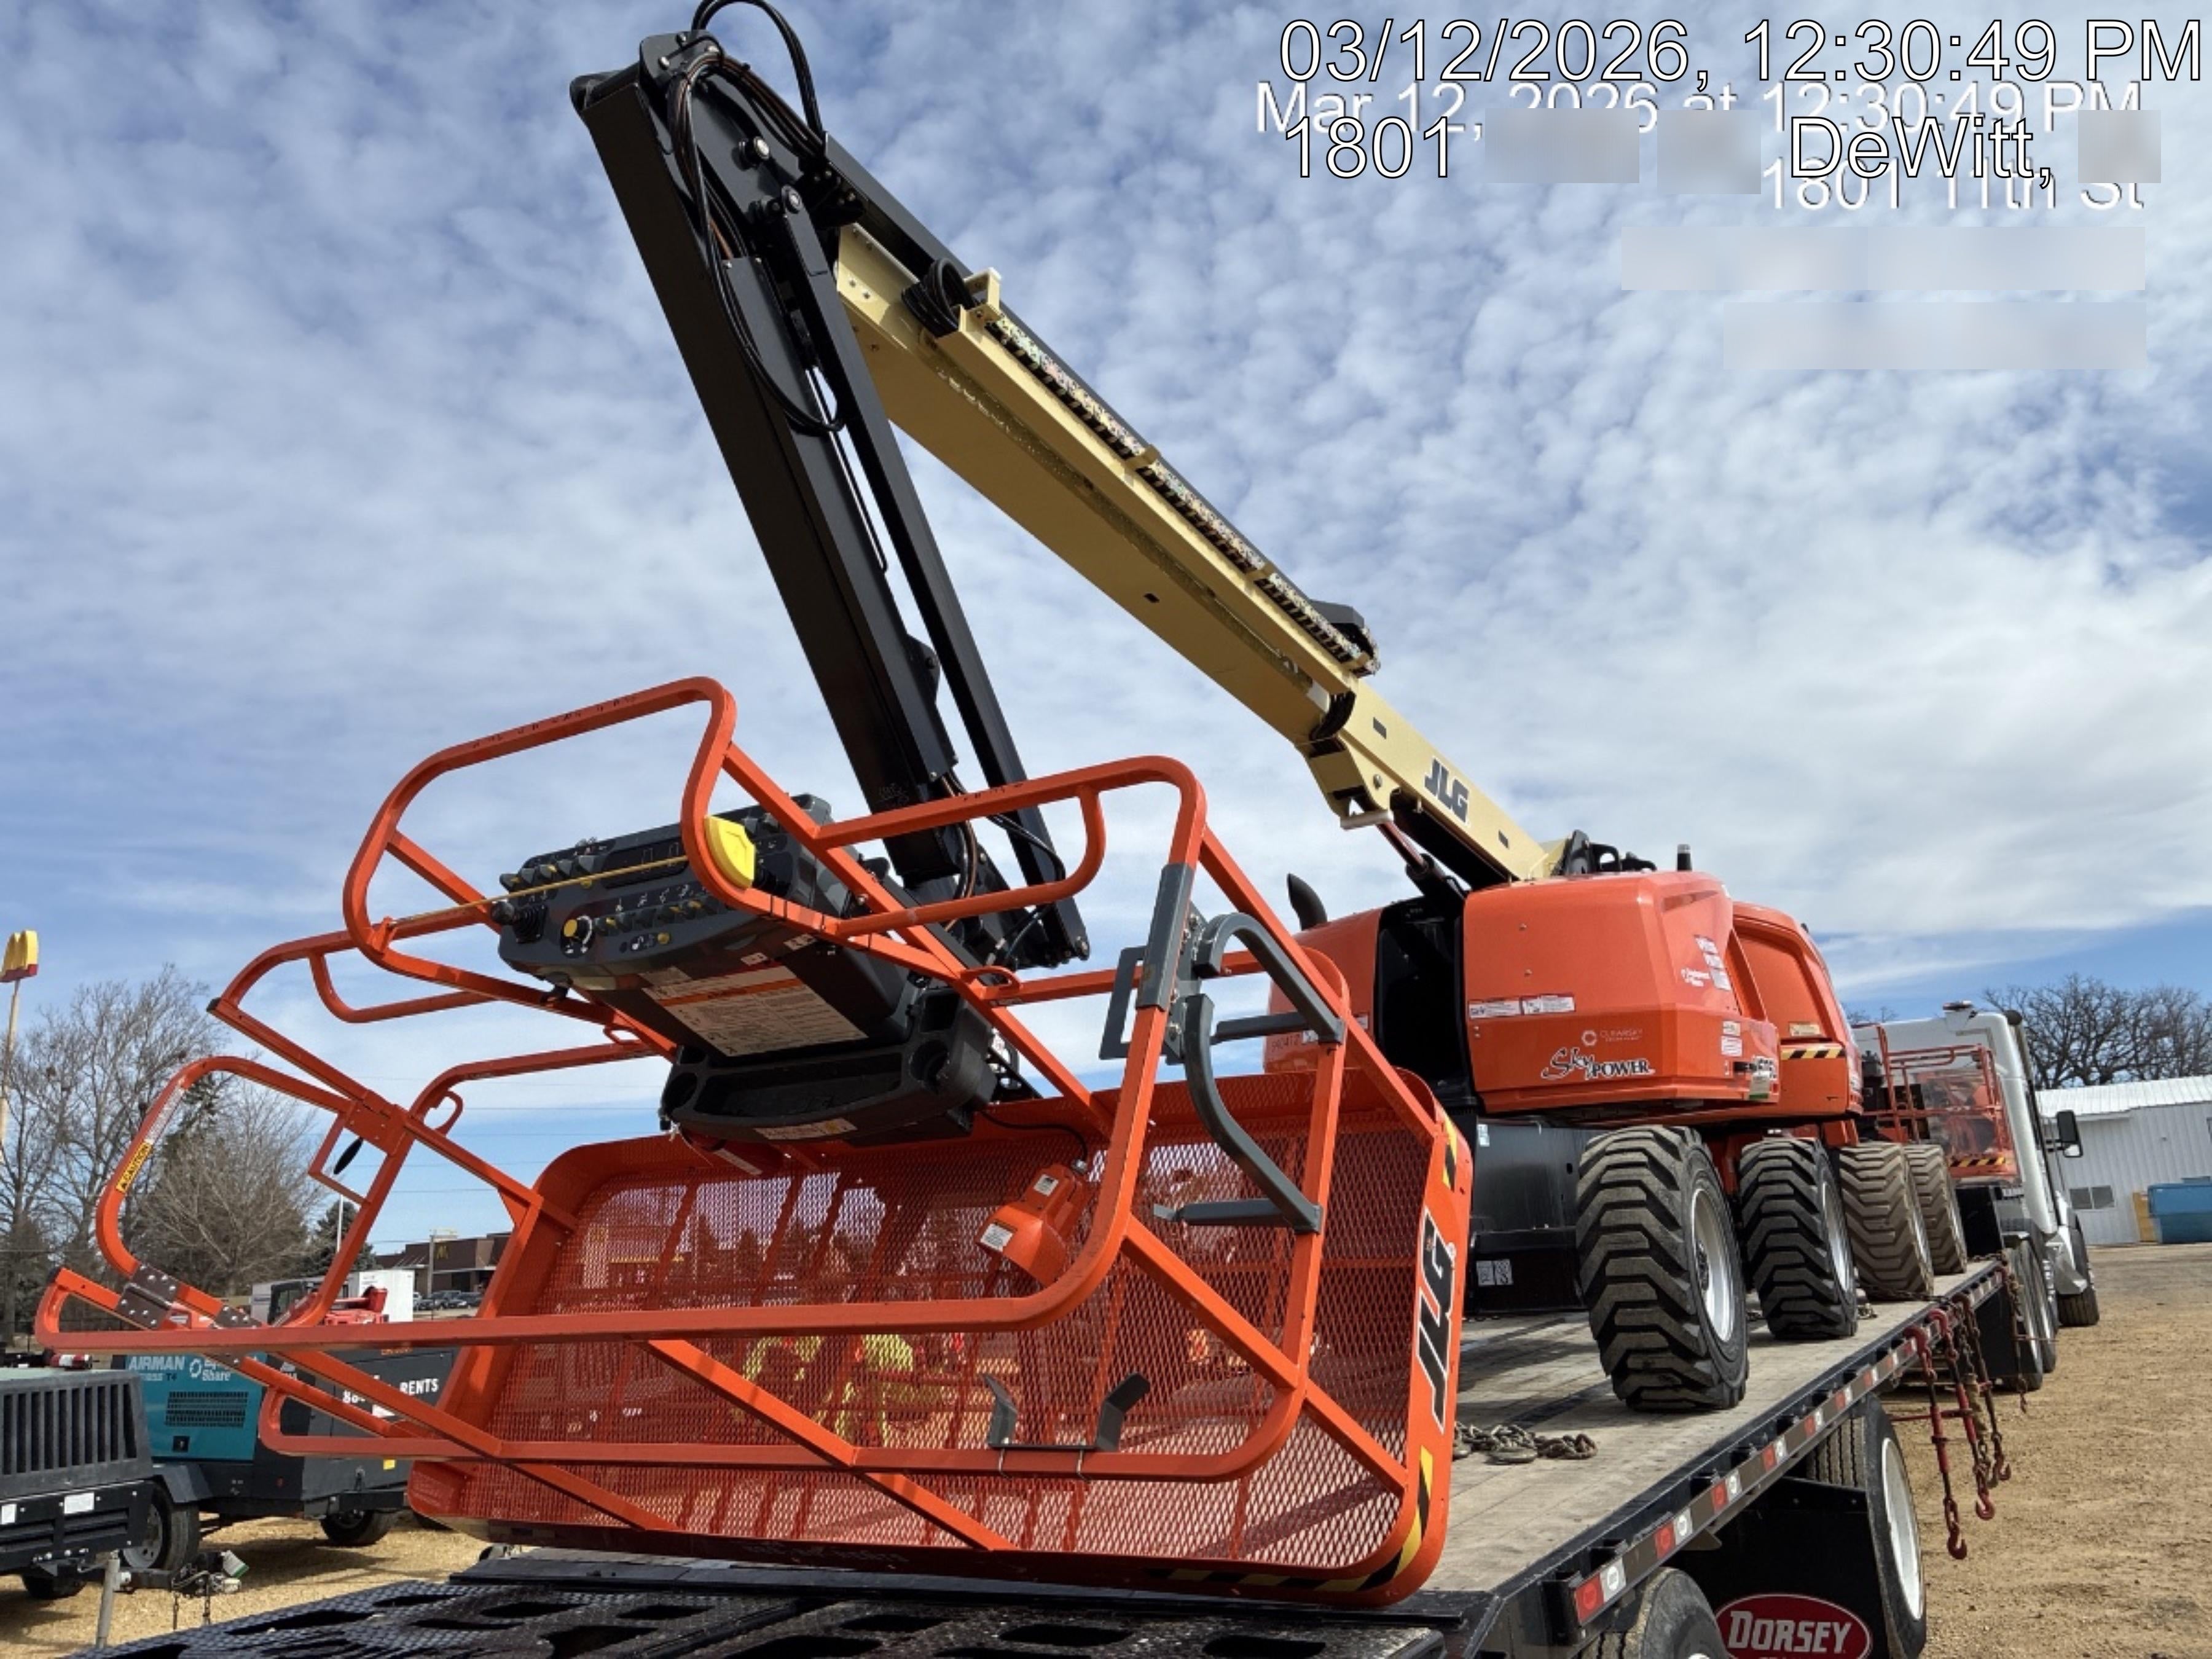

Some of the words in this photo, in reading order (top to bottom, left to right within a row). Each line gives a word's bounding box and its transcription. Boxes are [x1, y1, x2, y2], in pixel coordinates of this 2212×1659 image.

[1424, 756, 1469, 823] JLG
[1416, 1206, 1454, 1435] JLG
[128, 1355, 186, 1371] AIRMAN
[202, 1370, 232, 1381] Share
[399, 1378, 440, 1395] RENTS
[1728, 1610, 1852, 1654] DORSEY
